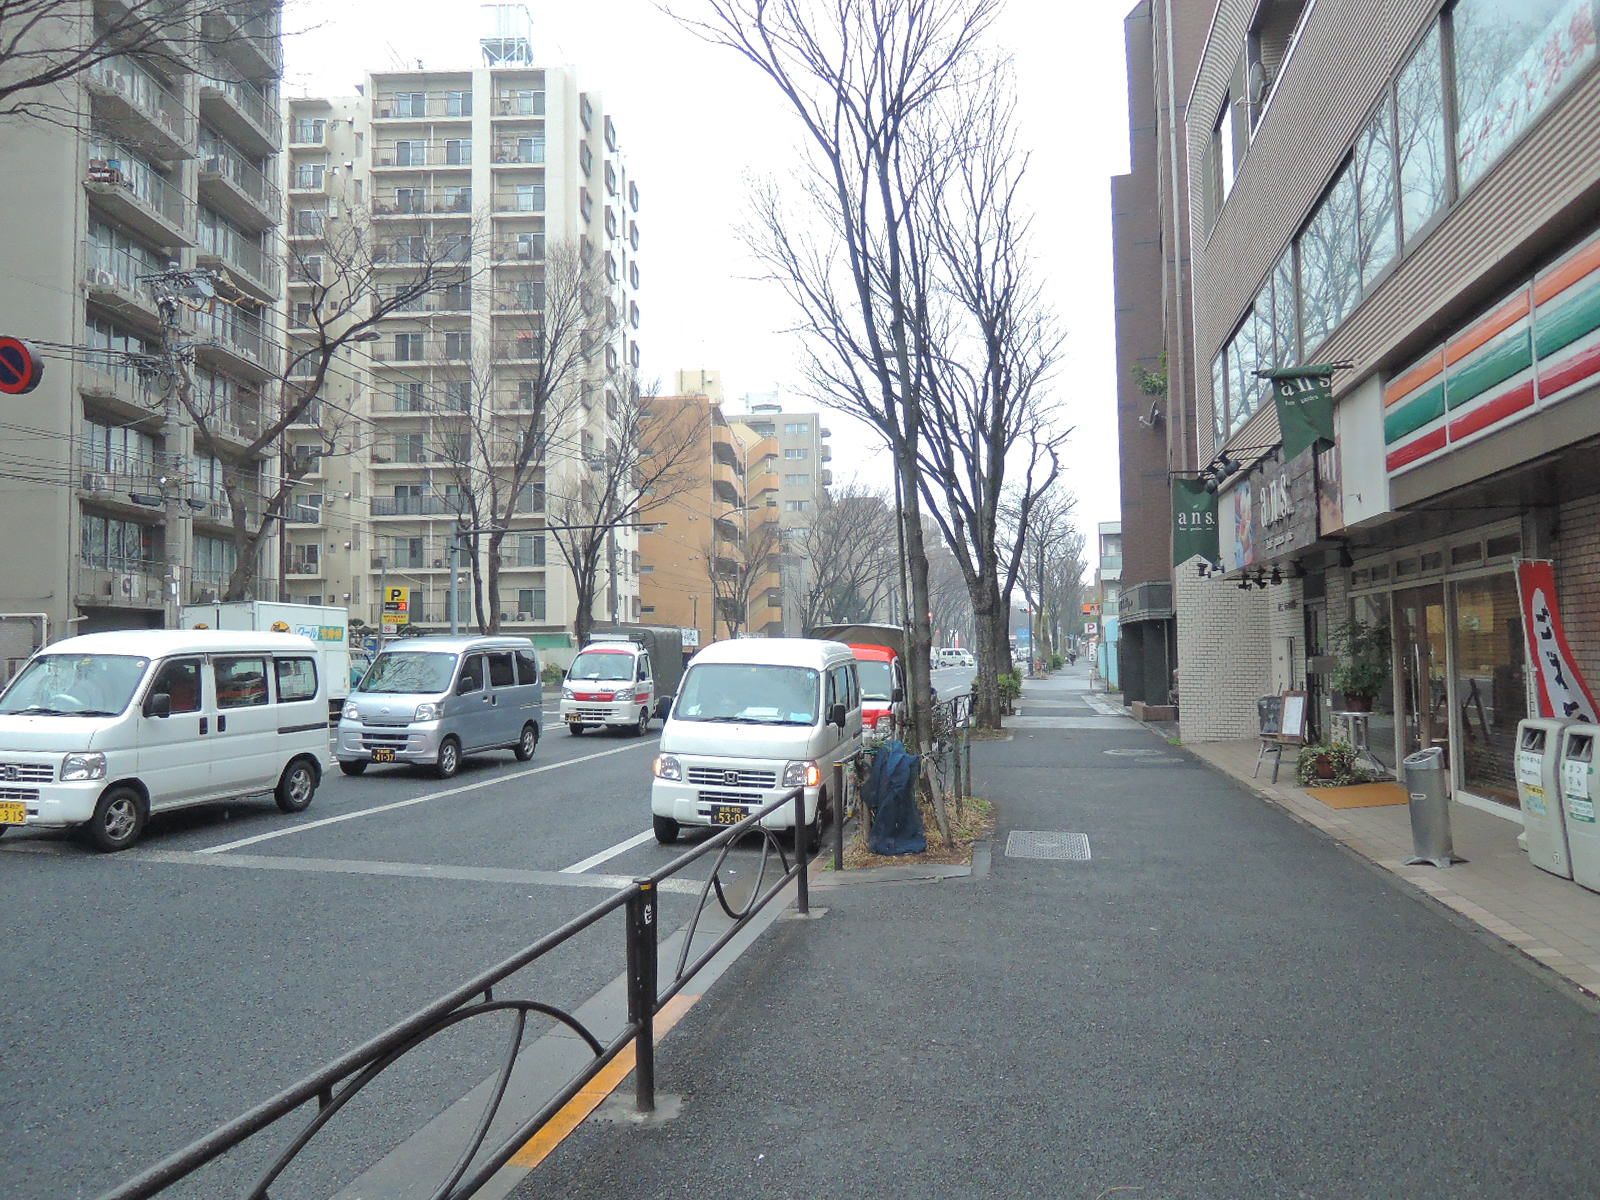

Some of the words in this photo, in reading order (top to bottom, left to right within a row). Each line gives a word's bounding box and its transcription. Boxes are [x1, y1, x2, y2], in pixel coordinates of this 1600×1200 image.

[1178, 511, 1216, 525] ans.
[391, 589, 402, 601] P
[1088, 623, 1095, 632] P
